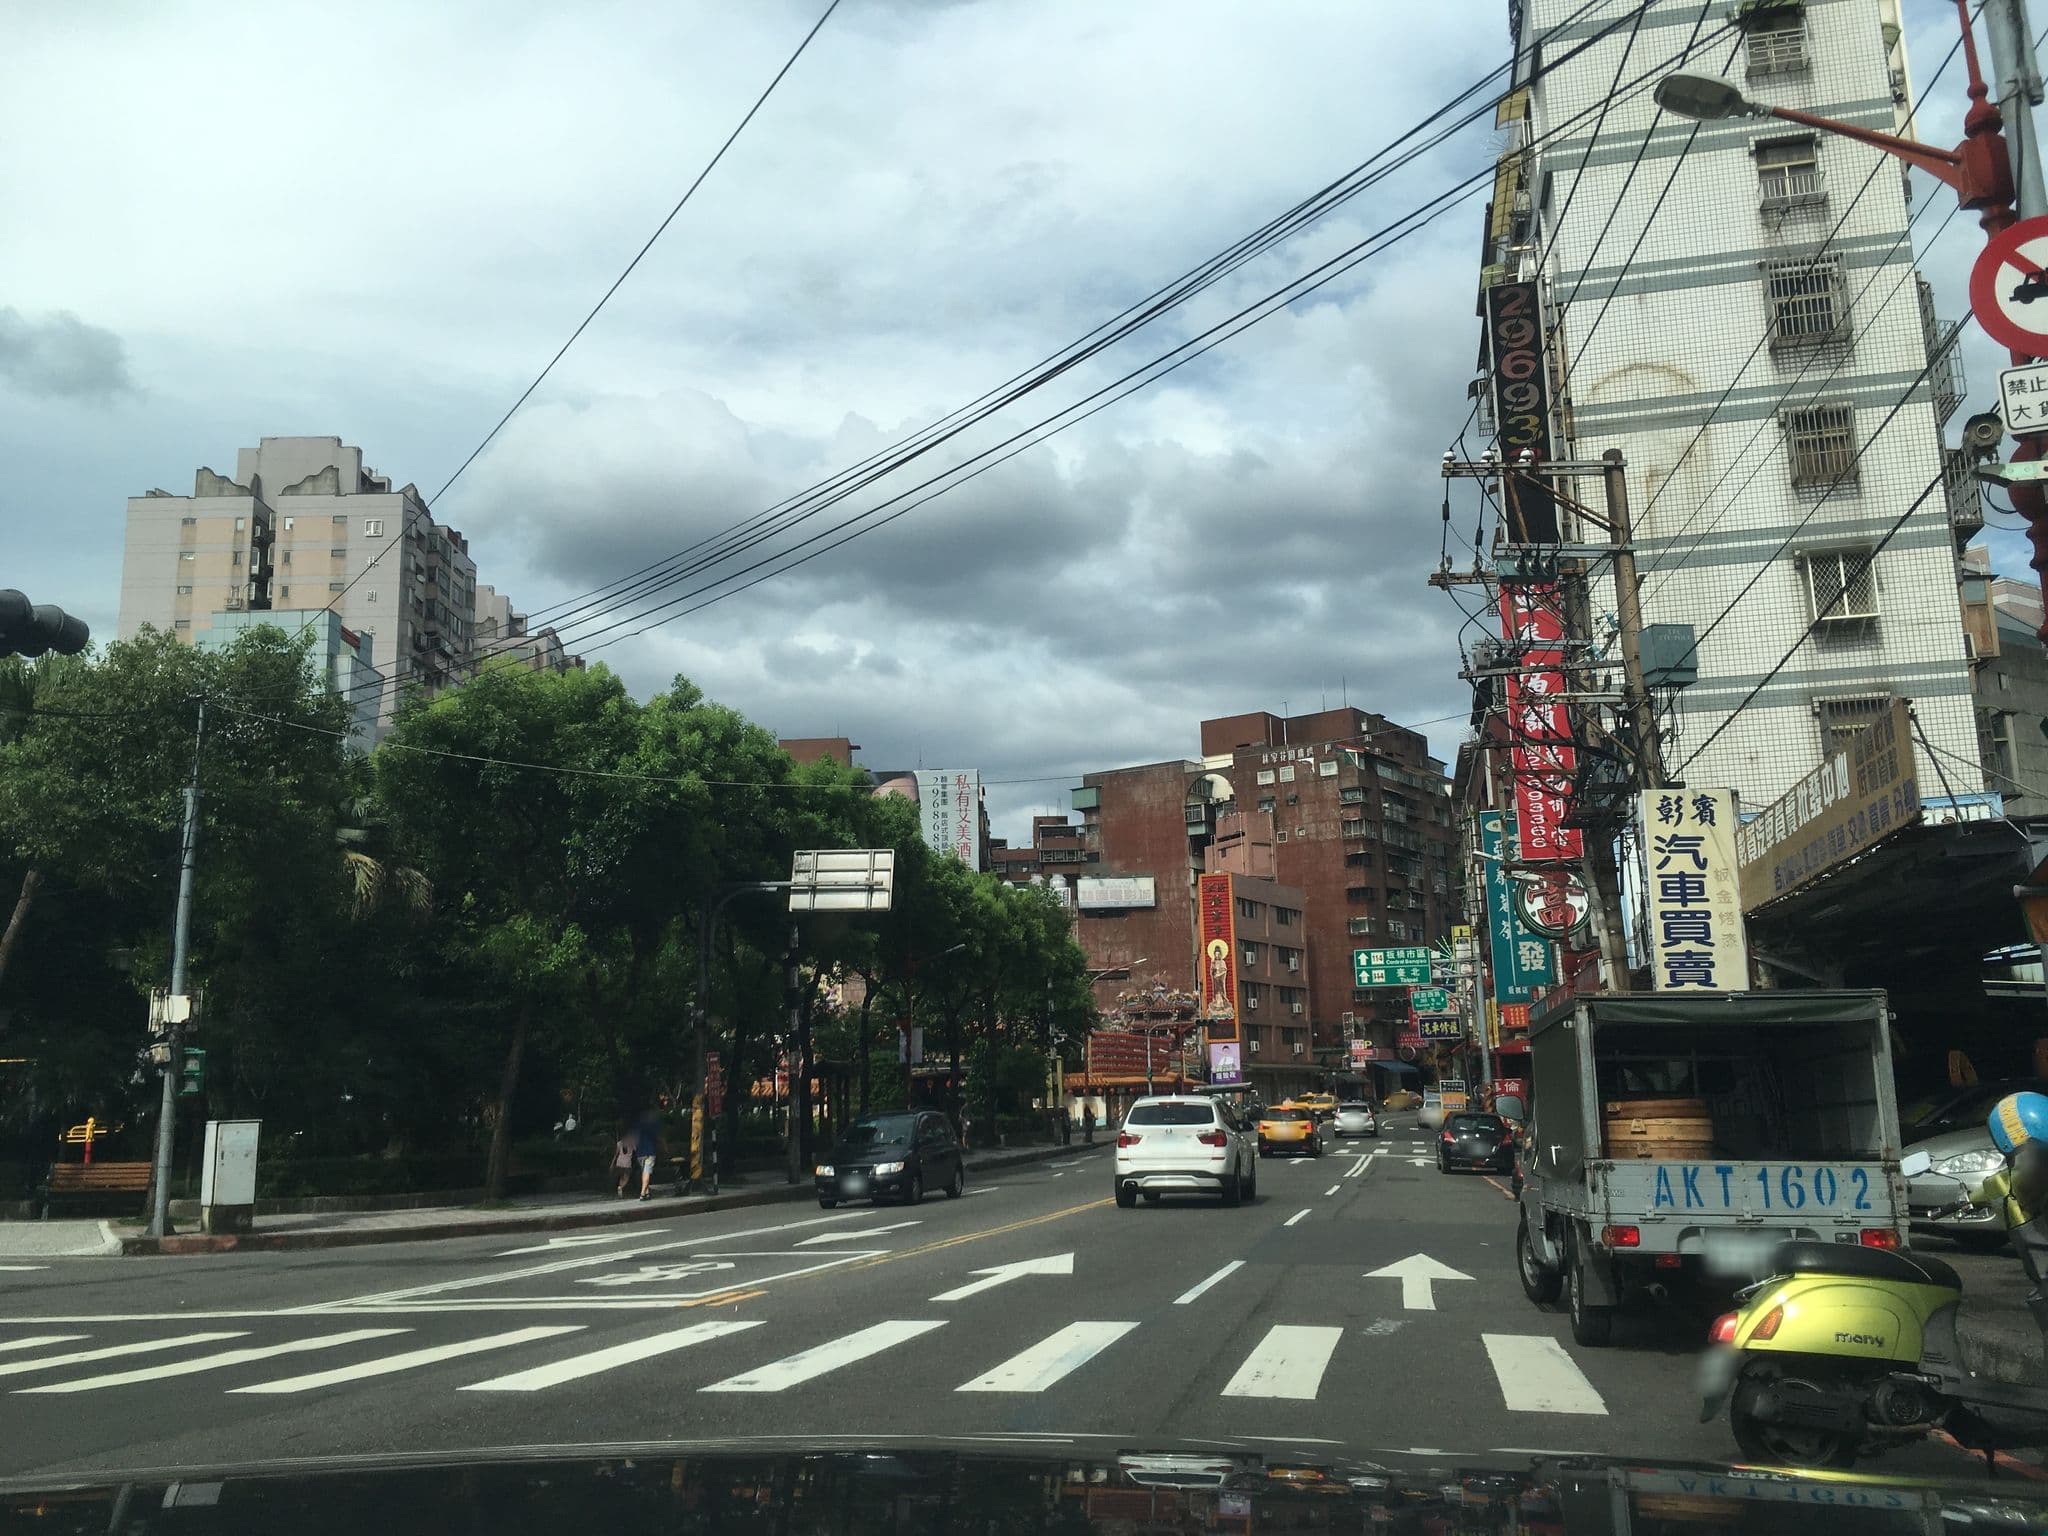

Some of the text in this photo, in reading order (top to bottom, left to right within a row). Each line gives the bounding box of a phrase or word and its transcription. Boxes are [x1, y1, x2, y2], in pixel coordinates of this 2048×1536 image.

[1498, 286, 1543, 460] 29693
[2008, 376, 2048, 396] 禁止
[956, 774, 971, 870] 私有艾美酒
[1655, 793, 1718, 827] 彰賓
[1653, 833, 1718, 988] 汽車買賣
[1386, 949, 1426, 959] 板橋市區
[1655, 1164, 1872, 1210] AKT 1602
[1834, 1331, 1885, 1347] many
